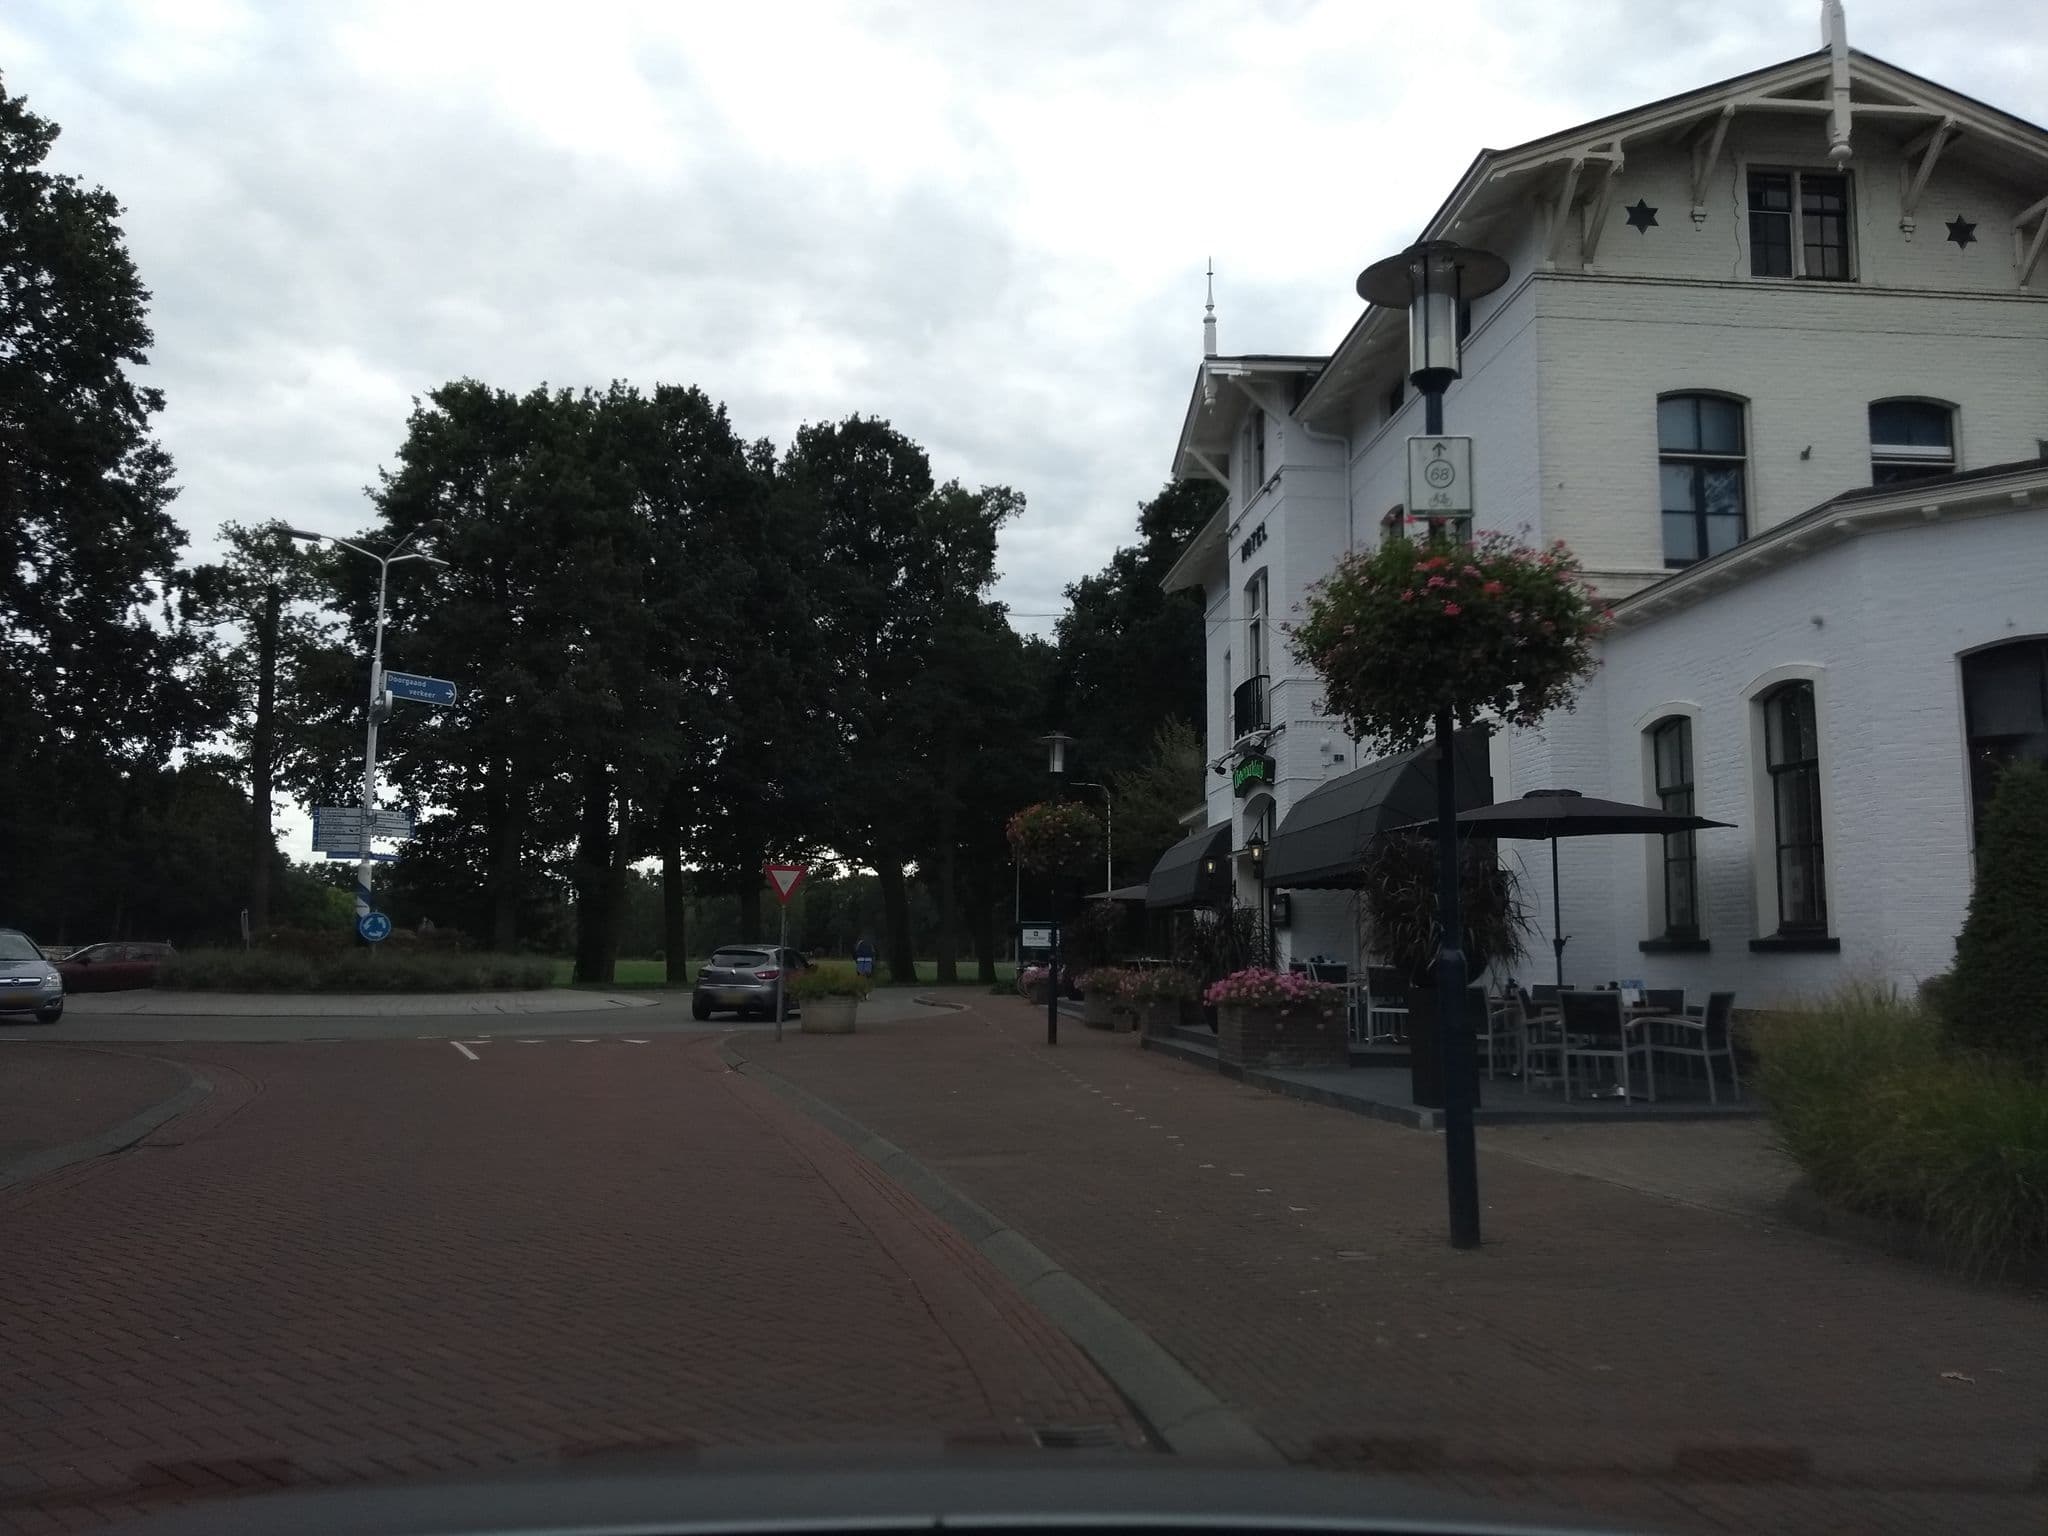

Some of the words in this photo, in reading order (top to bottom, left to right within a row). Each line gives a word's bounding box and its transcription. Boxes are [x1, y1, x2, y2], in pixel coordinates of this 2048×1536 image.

[1431, 467, 1449, 480] 68
[1241, 521, 1268, 564] HOTEL
[388, 675, 427, 687] Doorgaand
[409, 689, 436, 698] verkeer
